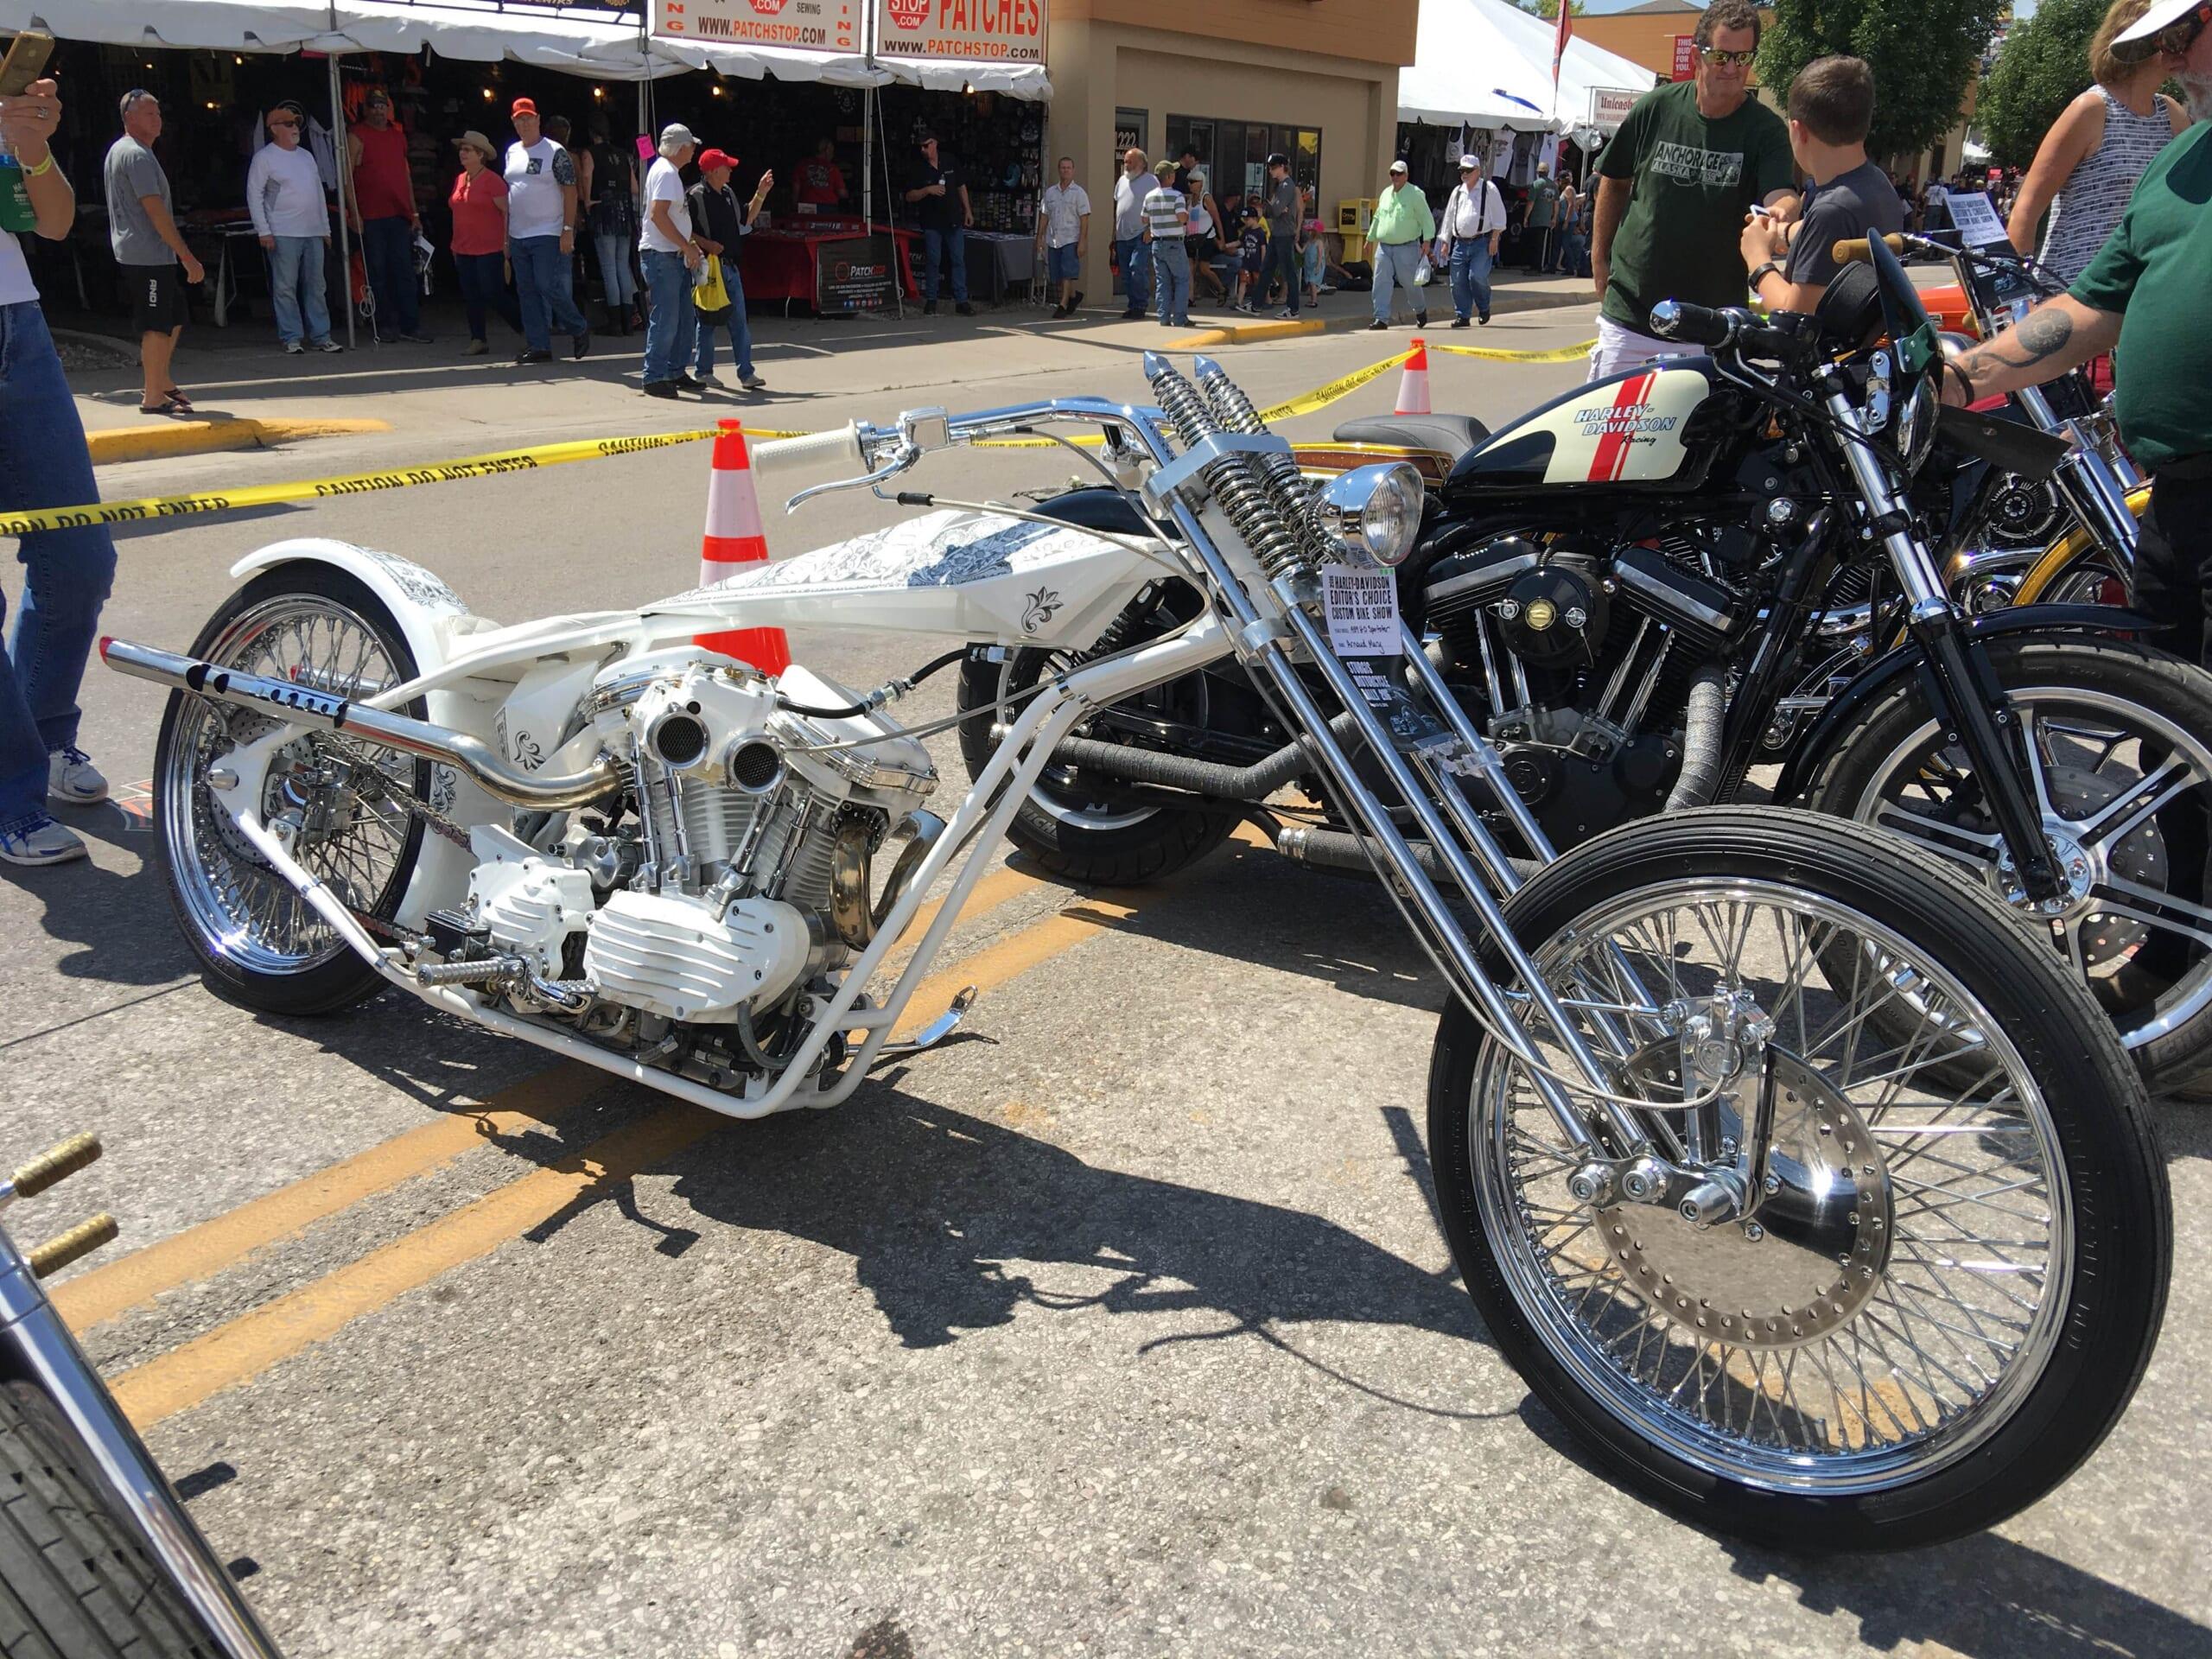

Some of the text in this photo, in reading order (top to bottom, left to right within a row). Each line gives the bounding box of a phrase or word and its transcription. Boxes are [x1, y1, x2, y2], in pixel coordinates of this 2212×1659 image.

[797, 2, 821, 15] SEWING
[939, 0, 1039, 36] PATCHES
[698, 16, 826, 44] WWW.PATCHSTOP.COM
[884, 39, 1039, 59] WWW.PATCHSTOP.COM
[1655, 143, 1723, 170] ANCHORAGE
[1651, 161, 1690, 180] ALASKA
[1573, 404, 1655, 423] HARLEY-
[1582, 417, 1677, 435] DAVIDSON
[1620, 435, 1656, 447] Racing
[1334, 575, 1390, 589] HARLEY-DAVIDSON
[1331, 589, 1392, 606] EDITOR'S CHOICE
[1332, 606, 1392, 620] CUSTOM BIKE SHOW
